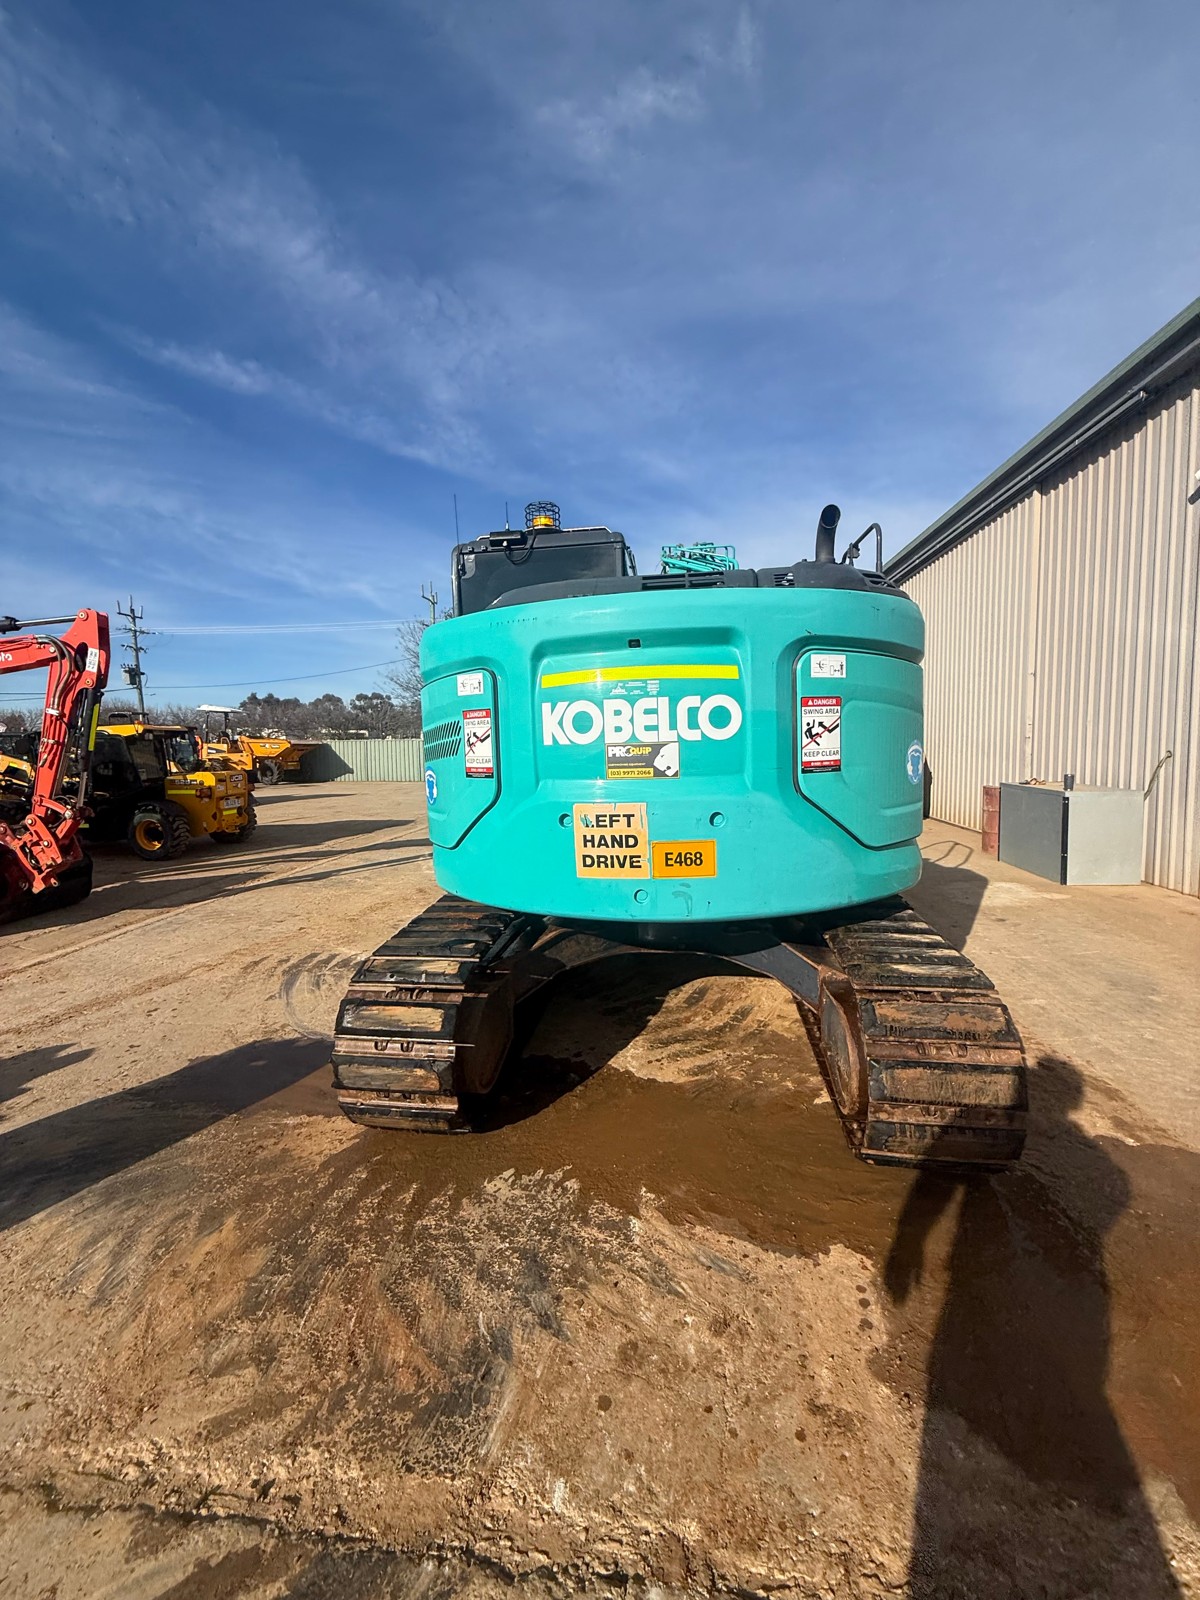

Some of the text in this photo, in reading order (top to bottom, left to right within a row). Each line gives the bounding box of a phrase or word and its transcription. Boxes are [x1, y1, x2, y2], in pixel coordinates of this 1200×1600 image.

[541, 694, 743, 746] KOBELCO
[582, 834, 639, 849] HAND
[581, 854, 642, 869] DRIVE
[664, 851, 704, 867] E468
